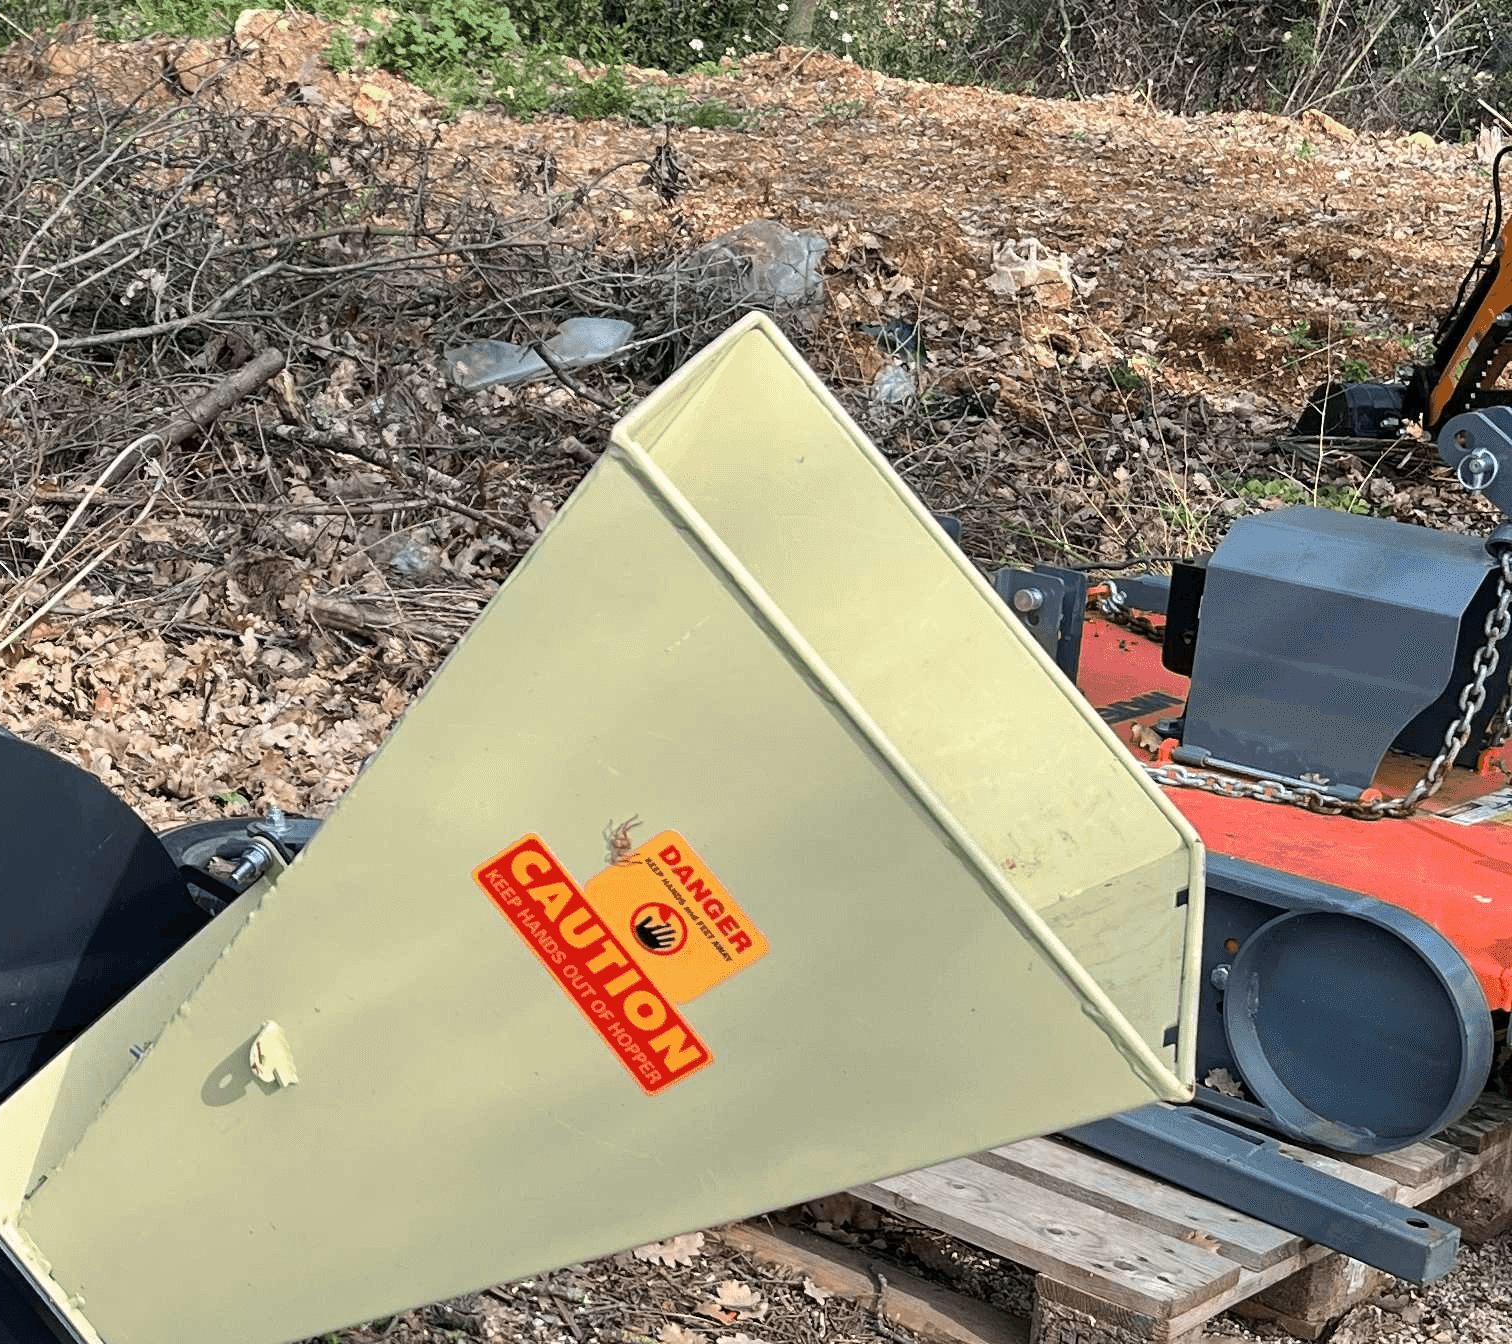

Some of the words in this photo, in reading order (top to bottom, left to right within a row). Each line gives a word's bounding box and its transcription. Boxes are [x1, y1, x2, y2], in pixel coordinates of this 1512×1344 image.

[485, 869, 522, 908] KEEP
[517, 905, 567, 965] HANDS
[563, 964, 598, 998] OUT
[591, 999, 615, 1023] OF
[607, 1022, 662, 1085] HOPPER
[511, 850, 702, 1073] CAUTION
[645, 857, 665, 878] KEEP
[663, 875, 687, 906] HANDS
[695, 918, 715, 940] FEET
[711, 939, 733, 963] AWAY
[658, 844, 752, 954] DANGER
